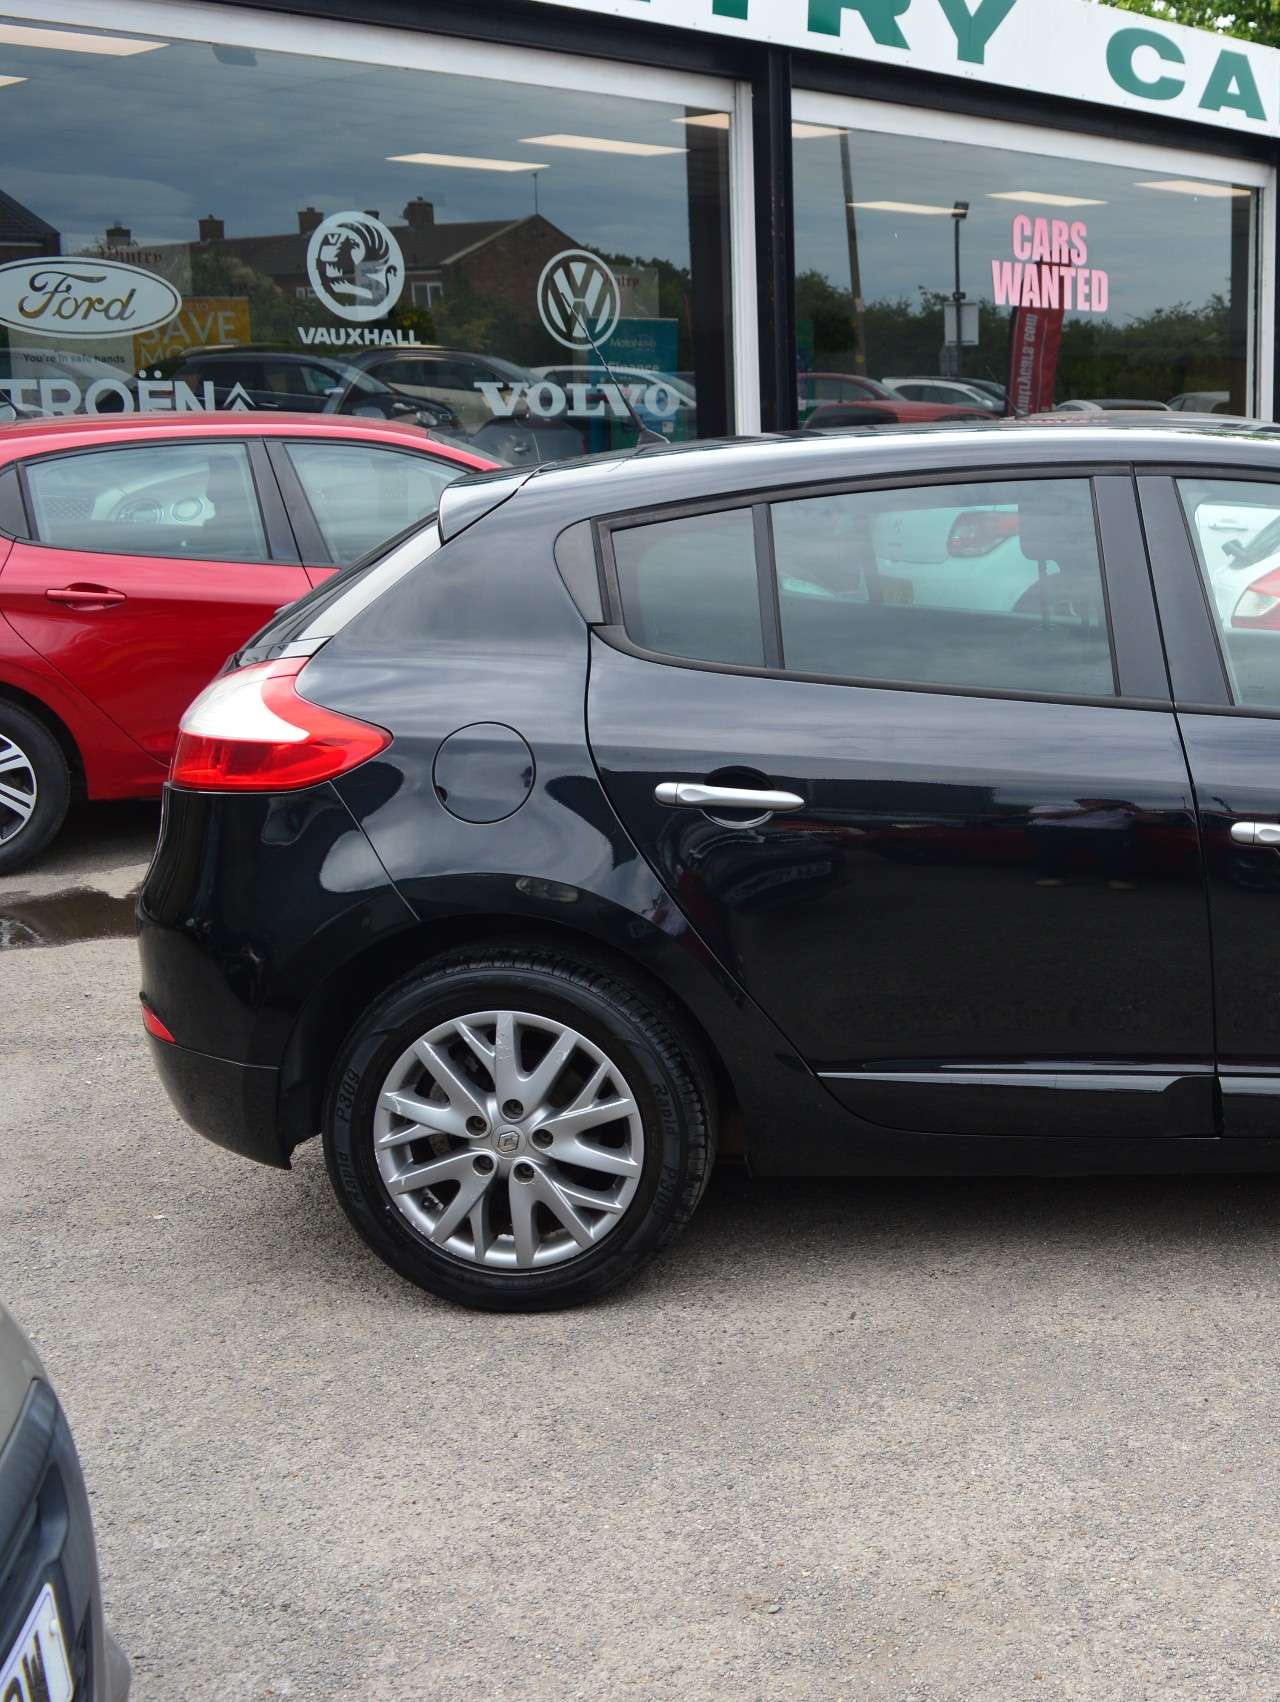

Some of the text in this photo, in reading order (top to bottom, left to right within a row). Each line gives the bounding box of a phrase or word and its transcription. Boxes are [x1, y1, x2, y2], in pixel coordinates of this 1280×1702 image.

[1013, 214, 1088, 266] CARS
[18, 270, 137, 321] Ford
[992, 260, 1109, 312] WANTED
[297, 326, 421, 346] VAUXHALL
[23, 353, 56, 364] You're
[94, 354, 126, 364] hands
[473, 381, 680, 417] VOLVO
